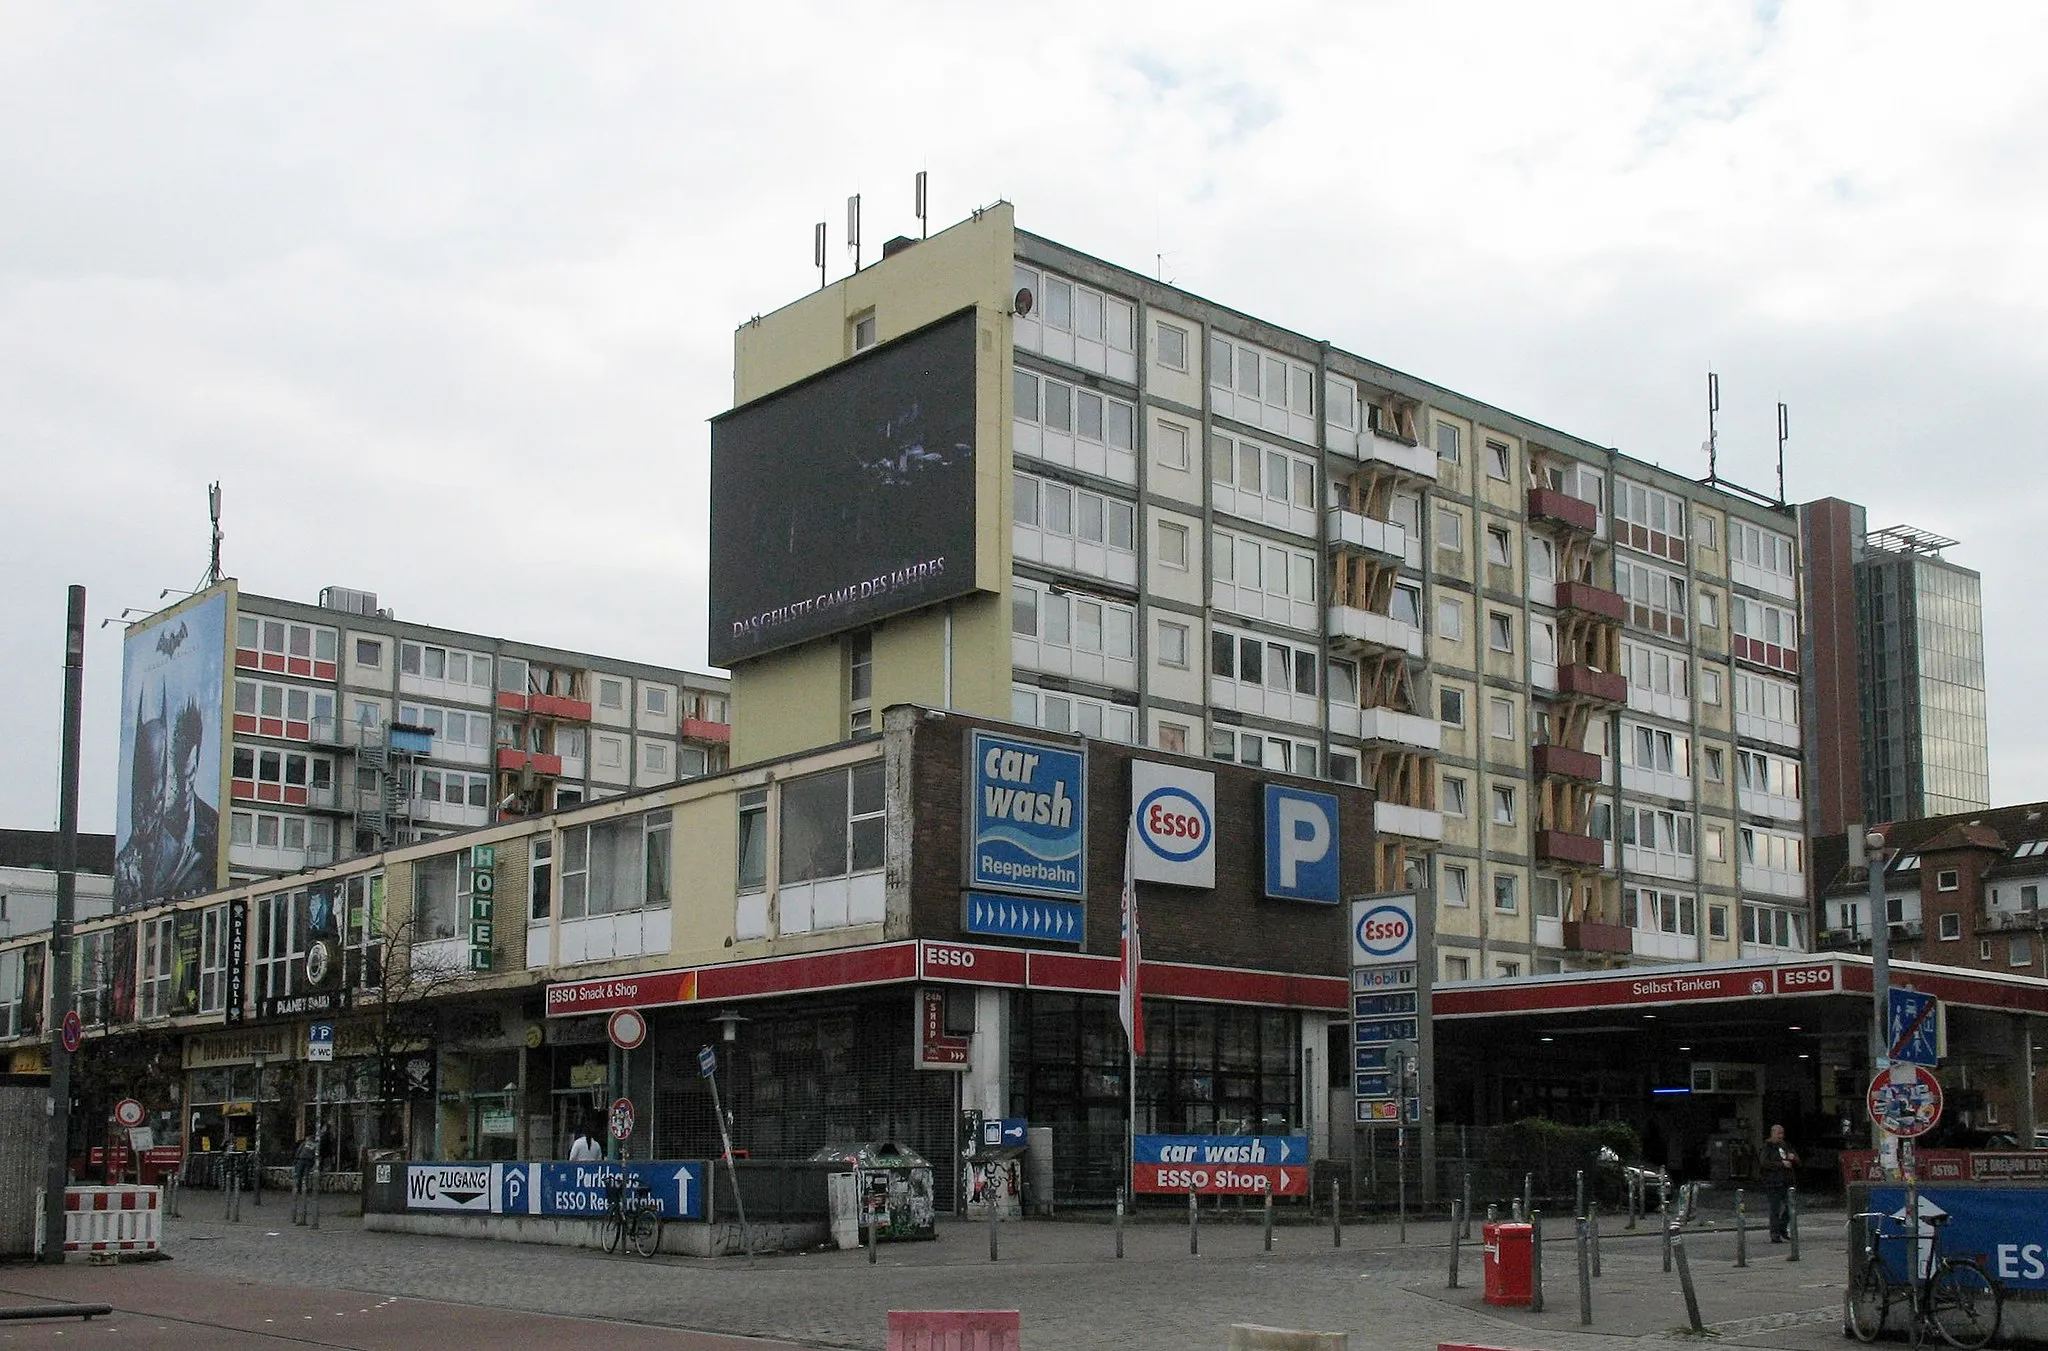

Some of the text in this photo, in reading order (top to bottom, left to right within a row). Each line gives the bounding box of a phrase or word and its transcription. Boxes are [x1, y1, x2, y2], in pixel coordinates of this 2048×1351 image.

[732, 556, 945, 638] DAS GEILSTE GAME DES JAHRES
[984, 747, 1040, 784] car
[984, 781, 1073, 828] wash
[1279, 797, 1330, 888] P
[982, 856, 1076, 883] Reeperbahn
[476, 846, 492, 969] HOTEL
[926, 947, 975, 967] ESSO
[1363, 970, 1397, 987] Mobil
[1632, 979, 1720, 995] Selbst Tanken
[1785, 969, 1831, 985] ESSO
[550, 983, 638, 1004] ESSO Snack & Shop
[925, 992, 942, 1001] 24h
[321, 1029, 329, 1040] P
[318, 1048, 331, 1056] WC
[1160, 1138, 1265, 1163] car wash
[439, 1172, 486, 1189] ZUGANG
[1158, 1169, 1268, 1191] ESSO Shop
[1931, 1164, 1959, 1177] ASTRA
[410, 1174, 436, 1201] WC
[510, 1180, 520, 1206] P
[556, 1191, 586, 1210] ESSO
[1998, 1244, 2048, 1279] ES
